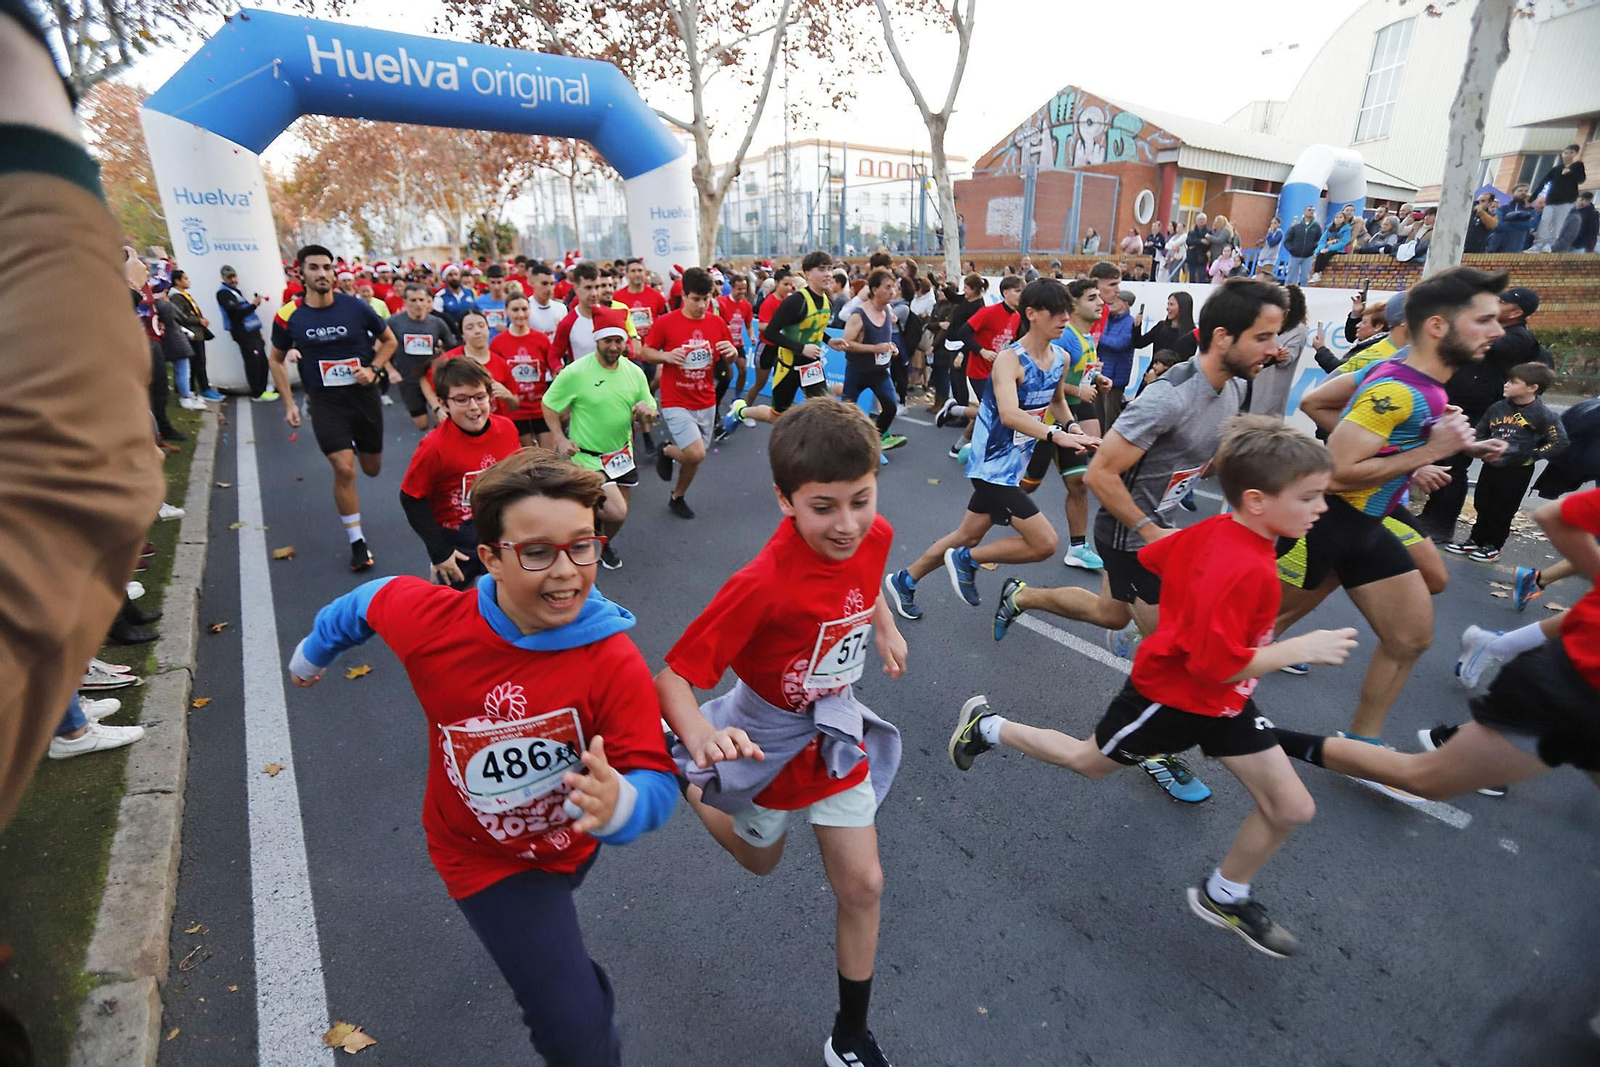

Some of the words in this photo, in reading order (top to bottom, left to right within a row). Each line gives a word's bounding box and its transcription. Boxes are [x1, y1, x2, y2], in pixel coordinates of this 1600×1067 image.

[306, 34, 460, 91] Huelva
[471, 62, 590, 109] original
[173, 187, 250, 206] Huelva
[213, 243, 259, 251] HUELVA
[306, 326, 348, 338] COPO
[691, 350, 706, 361] 389
[332, 367, 352, 377] 454
[518, 366, 530, 375] 20
[483, 741, 552, 783] 486
